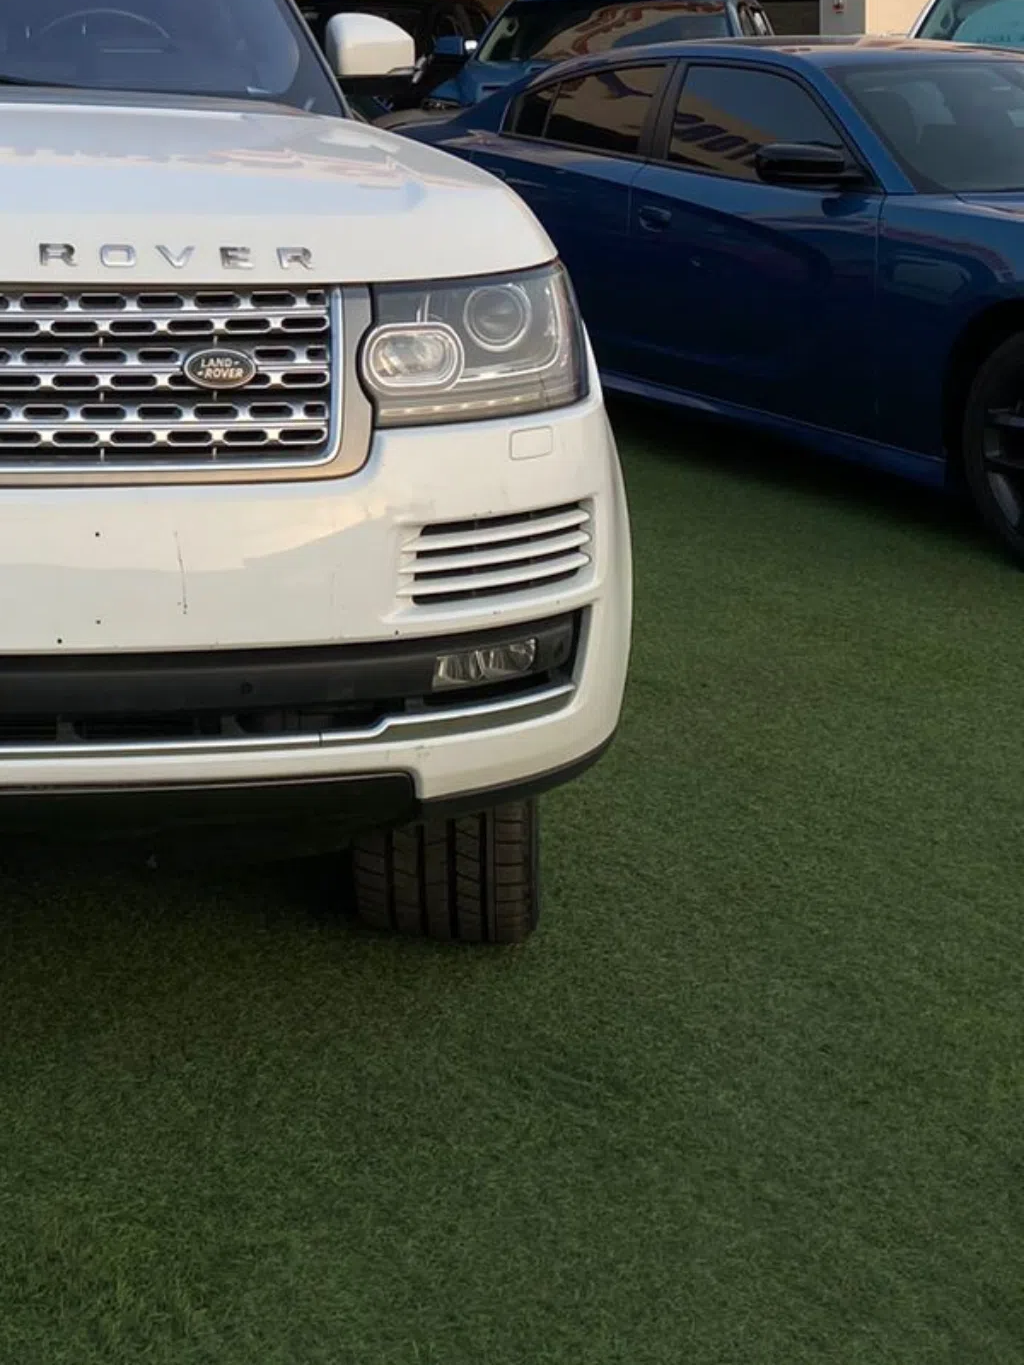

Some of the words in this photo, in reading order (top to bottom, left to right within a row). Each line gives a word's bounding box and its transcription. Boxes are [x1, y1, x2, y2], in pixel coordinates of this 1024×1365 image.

[38, 242, 315, 270] ROVER
[200, 357, 233, 368] LAND
[204, 367, 244, 379] ROVER
